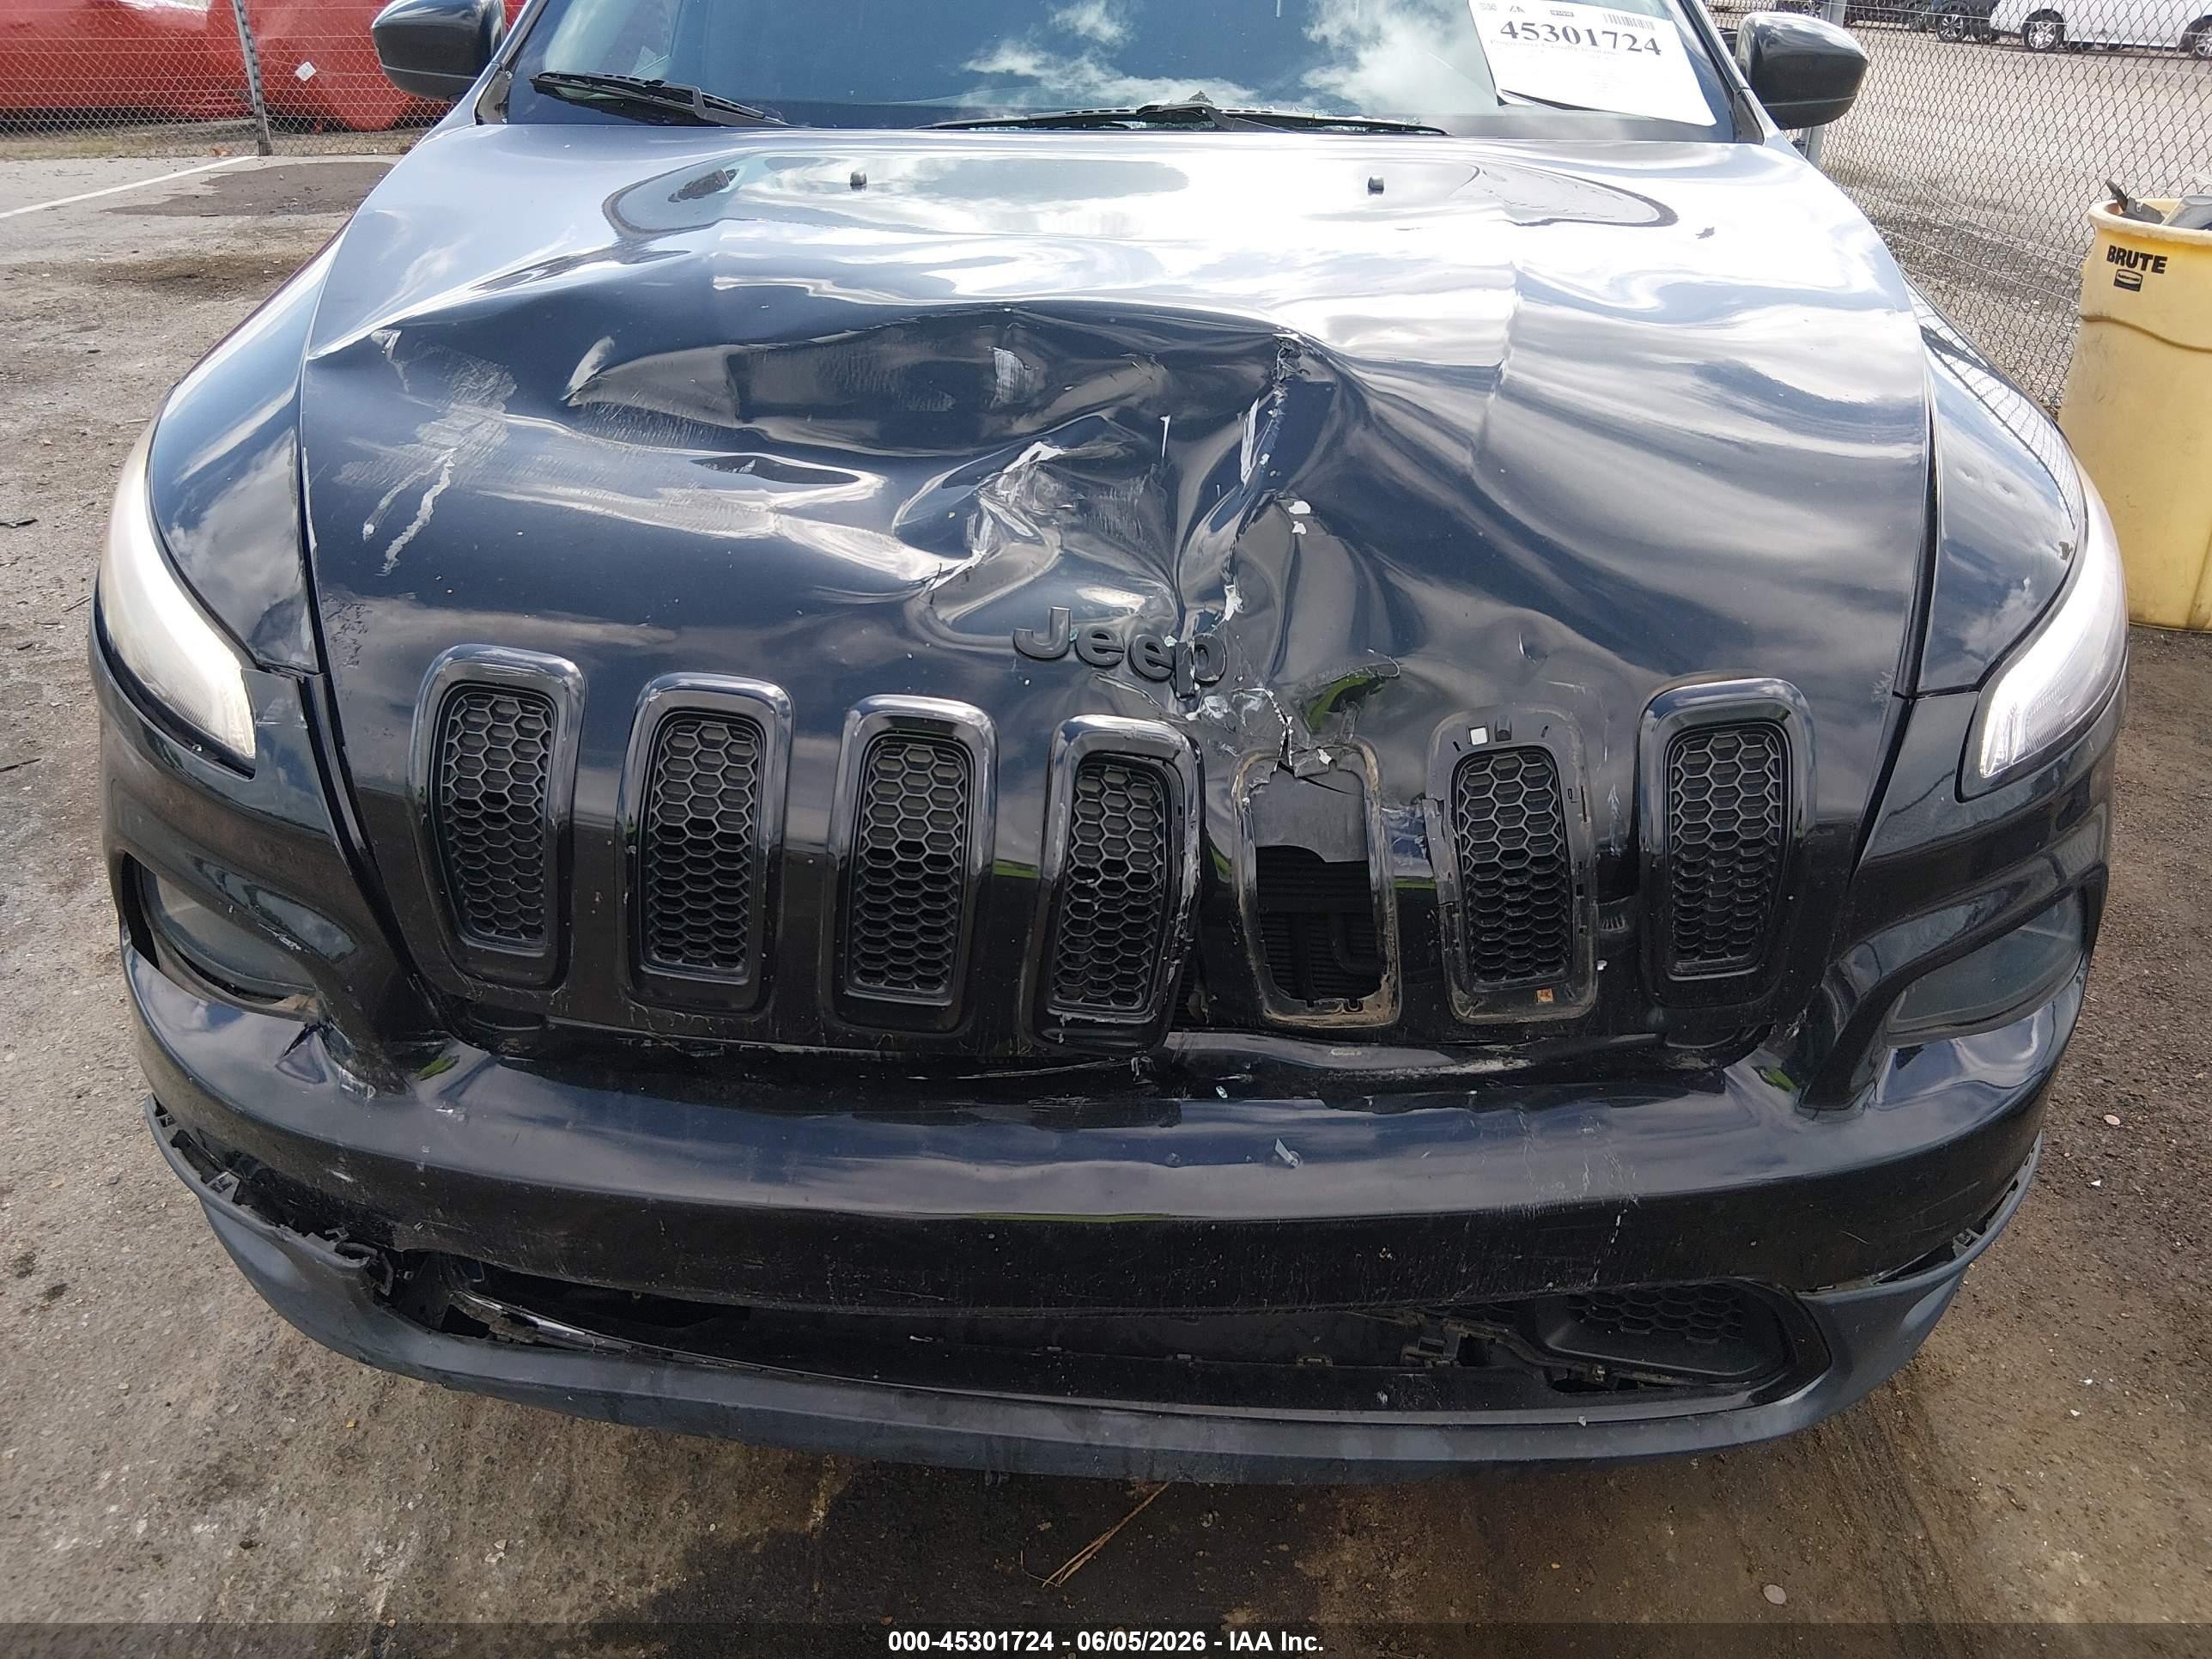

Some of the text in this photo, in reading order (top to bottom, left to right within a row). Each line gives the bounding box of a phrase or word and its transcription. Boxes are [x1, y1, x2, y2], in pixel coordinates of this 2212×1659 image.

[1500, 21, 1662, 56] 45301724
[2106, 245, 2168, 274] BRUTE
[1012, 606, 1227, 701] Jeep
